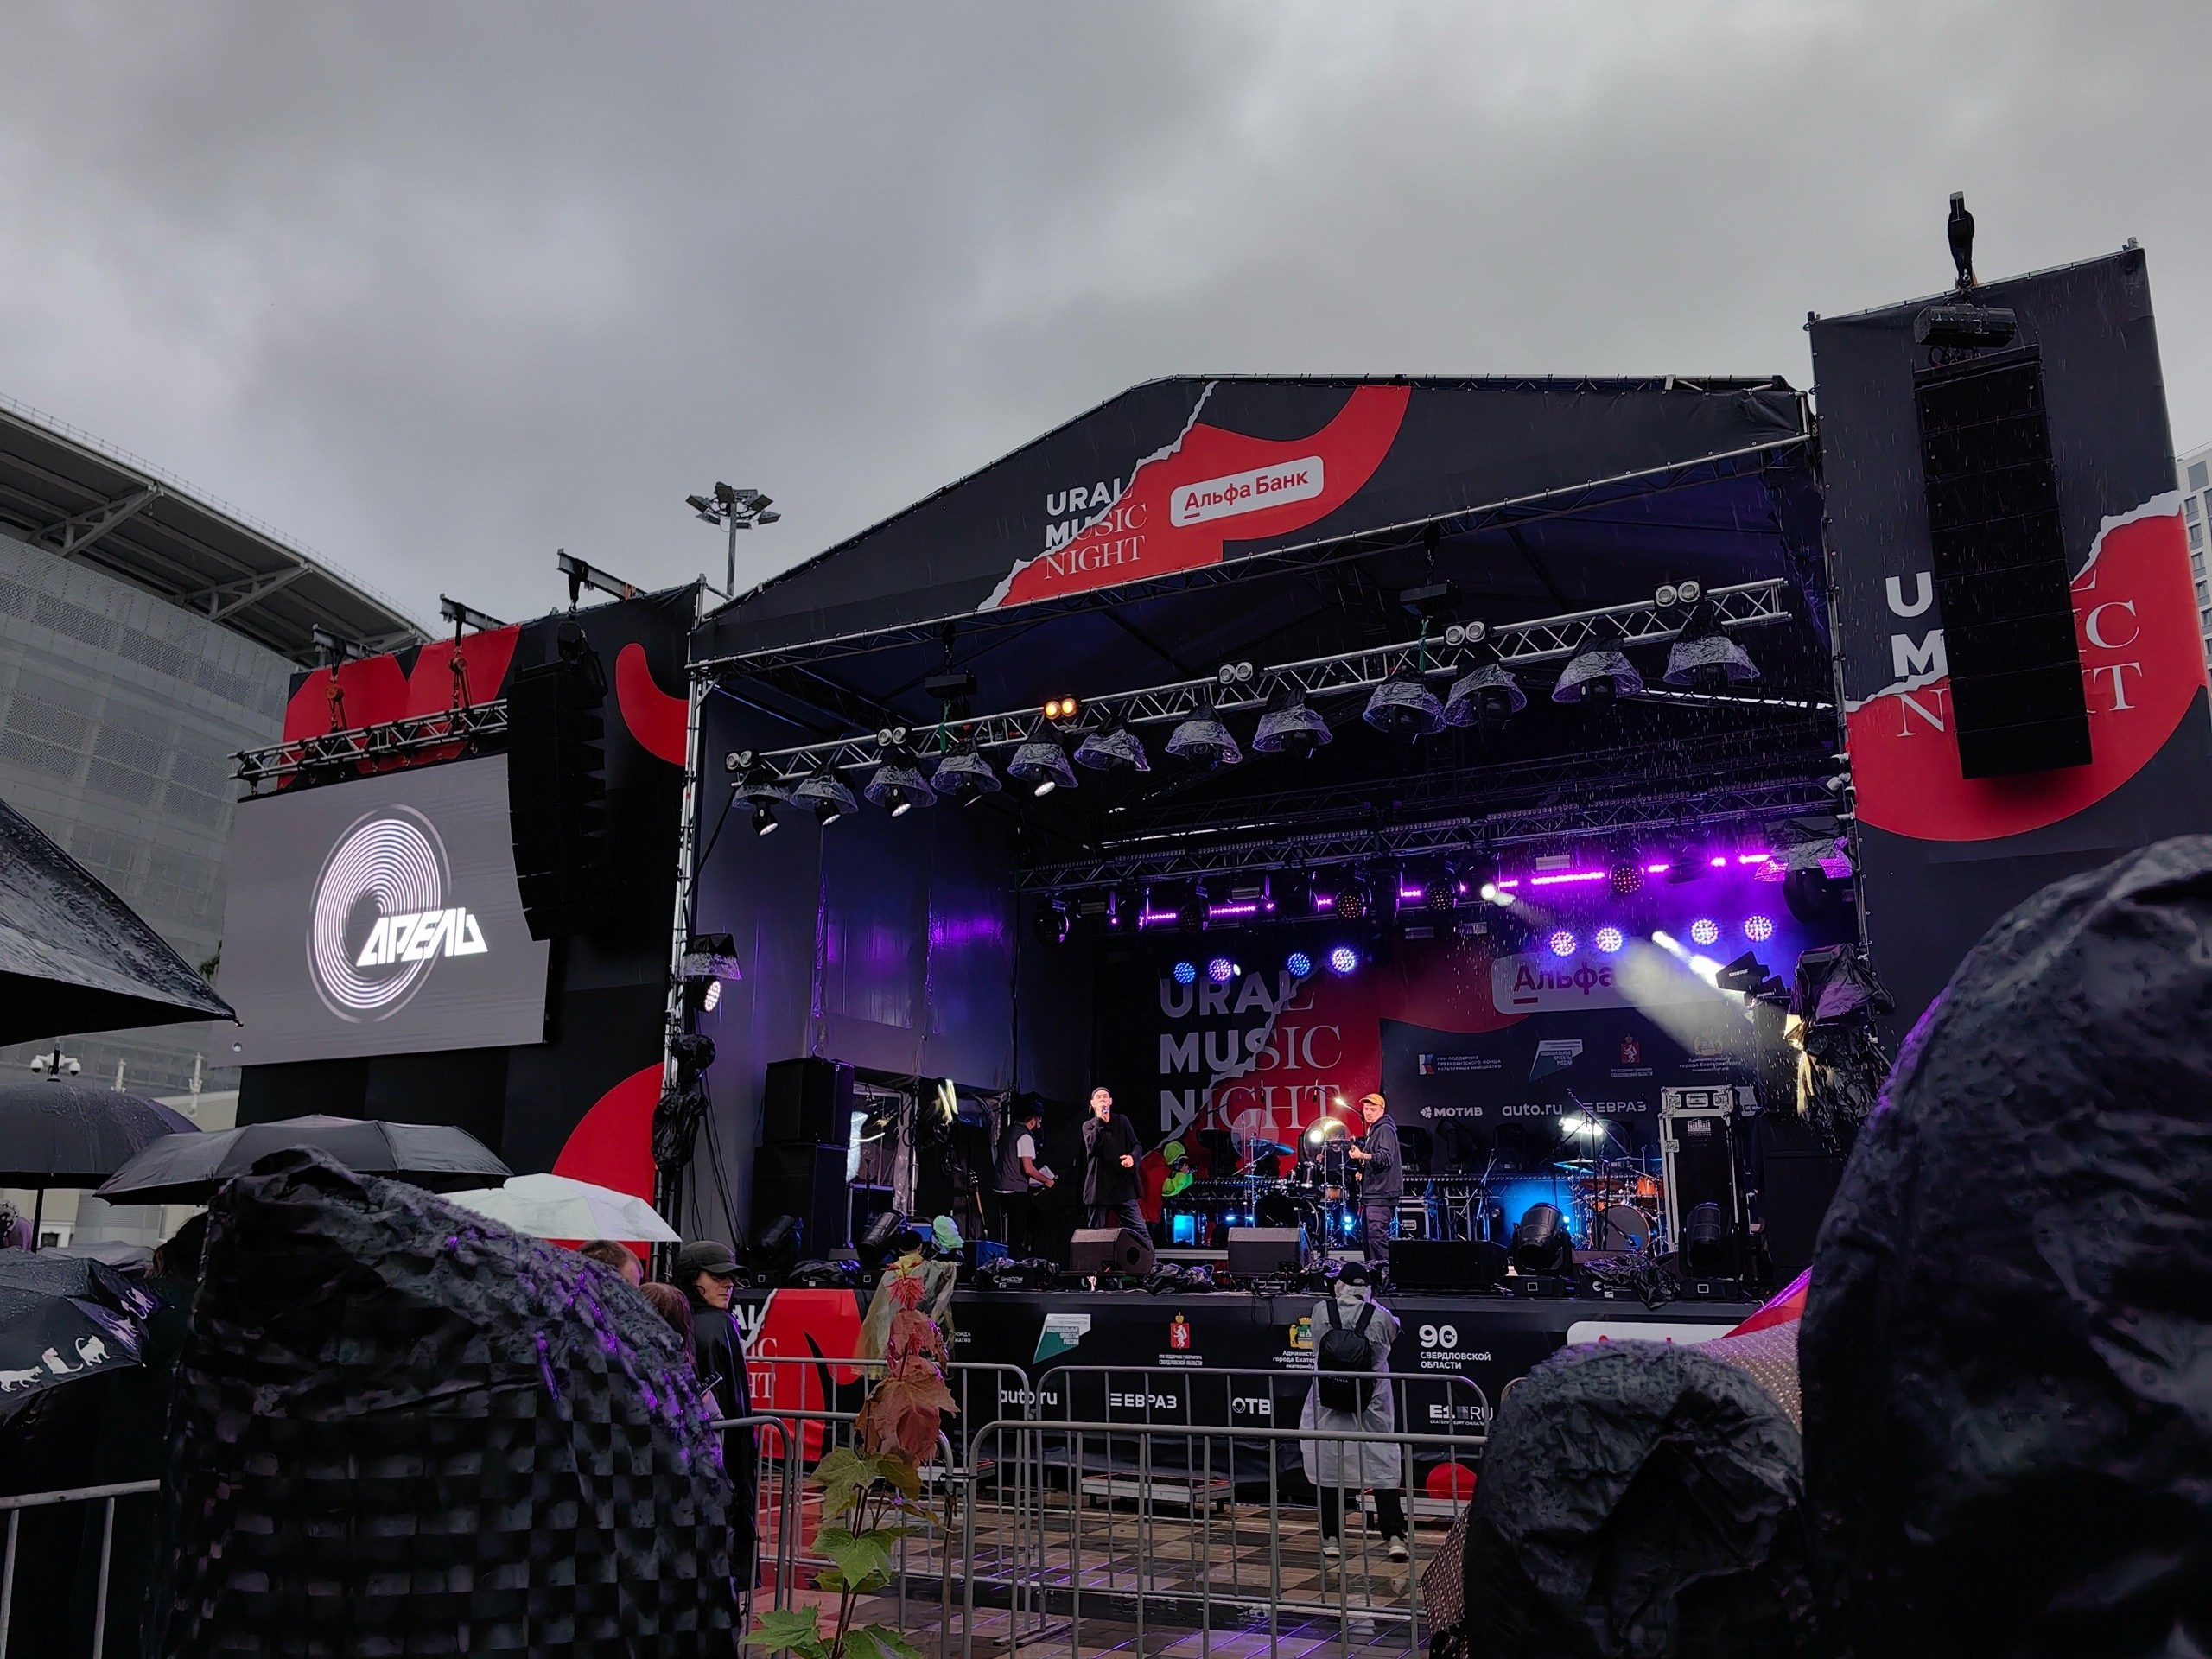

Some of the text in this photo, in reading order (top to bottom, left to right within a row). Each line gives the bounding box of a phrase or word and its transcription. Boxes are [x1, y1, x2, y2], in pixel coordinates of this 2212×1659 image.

[1046, 477, 1134, 517] URAL
[1184, 470, 1309, 513] Альфа Банк
[1046, 503, 1147, 549] MUSIC
[1044, 535, 1146, 580] NIGHT
[1513, 962, 1617, 995] Альфа
[1160, 969, 1315, 1018] URAL
[1160, 1025, 1343, 1074] MUSIC
[1160, 1084, 1341, 1132] NIGHT
[1434, 1106, 1484, 1117] МОТИВ
[1502, 1103, 1563, 1116] auto.ru
[1596, 1101, 1647, 1113] ЕВРАЗ
[733, 1304, 765, 1330] AL
[1419, 1325, 1458, 1349] 90
[1420, 1351, 1491, 1362] СВЕРДЛОВСКОЙ
[1420, 1361, 1462, 1370] ОБЛАСТИ
[1001, 1389, 1058, 1405] autoru
[1232, 1397, 1271, 1414] ОТВ
